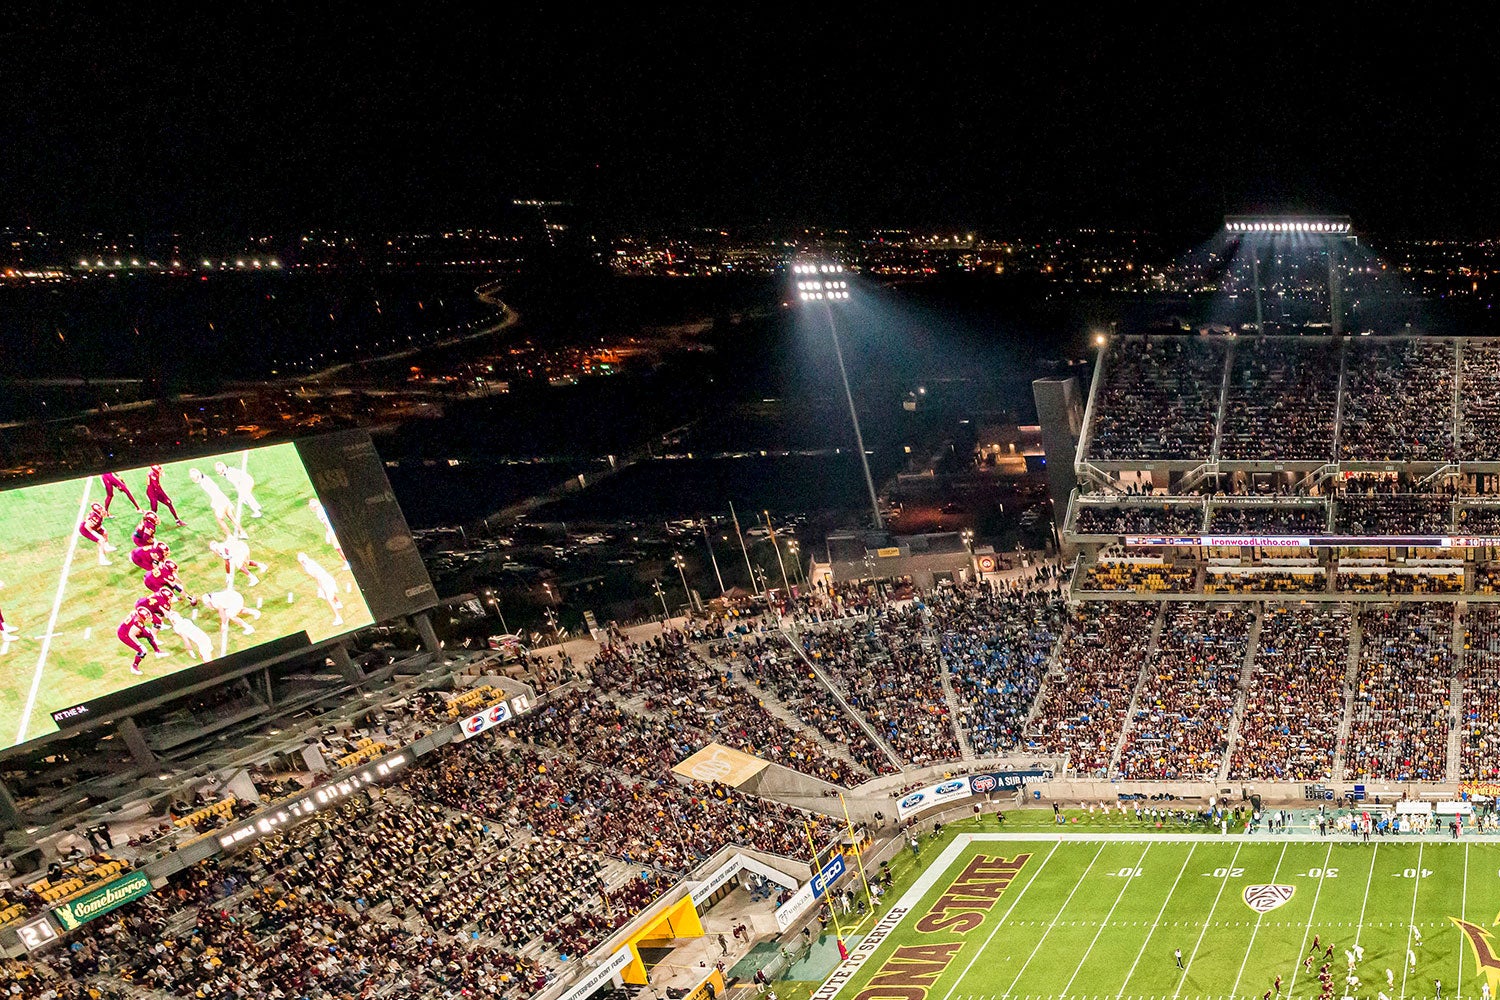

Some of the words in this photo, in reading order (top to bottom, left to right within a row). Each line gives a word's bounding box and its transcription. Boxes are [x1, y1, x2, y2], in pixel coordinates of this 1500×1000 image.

[1212, 538, 1300, 546] IronwoodLitho.com
[998, 778, 1004, 786] A
[1005, 777, 1020, 786] SUB
[814, 860, 842, 891] GEICO
[74, 877, 148, 918] Someburros
[914, 852, 1034, 936] STATE
[1247, 885, 1294, 900] PAC
[1256, 899, 1276, 908] 12
[846, 954, 866, 972] TO
[859, 907, 908, 953] SERVICE
